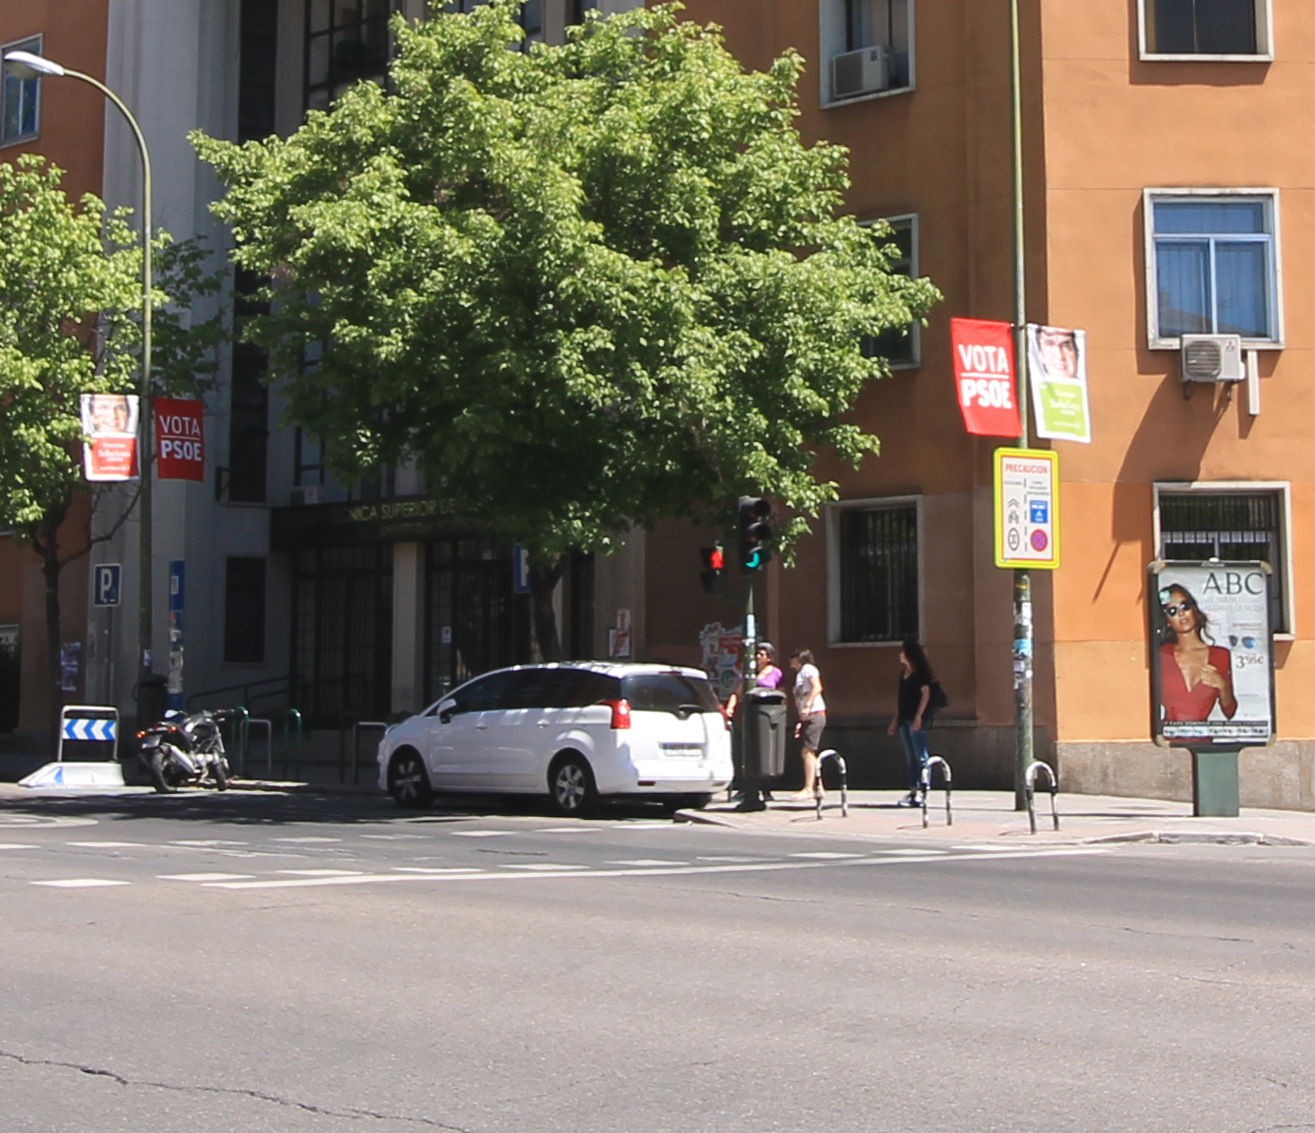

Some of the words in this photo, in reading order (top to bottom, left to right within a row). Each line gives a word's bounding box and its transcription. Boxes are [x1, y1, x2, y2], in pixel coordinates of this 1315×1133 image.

[958, 344, 1010, 374] VOTA
[961, 379, 1013, 409] PSOE
[159, 415, 201, 436] VOTA
[161, 440, 202, 461] PSOE
[381, 500, 436, 519] SUPERIOR
[100, 568, 112, 602] P
[1202, 572, 1264, 595] ABC
